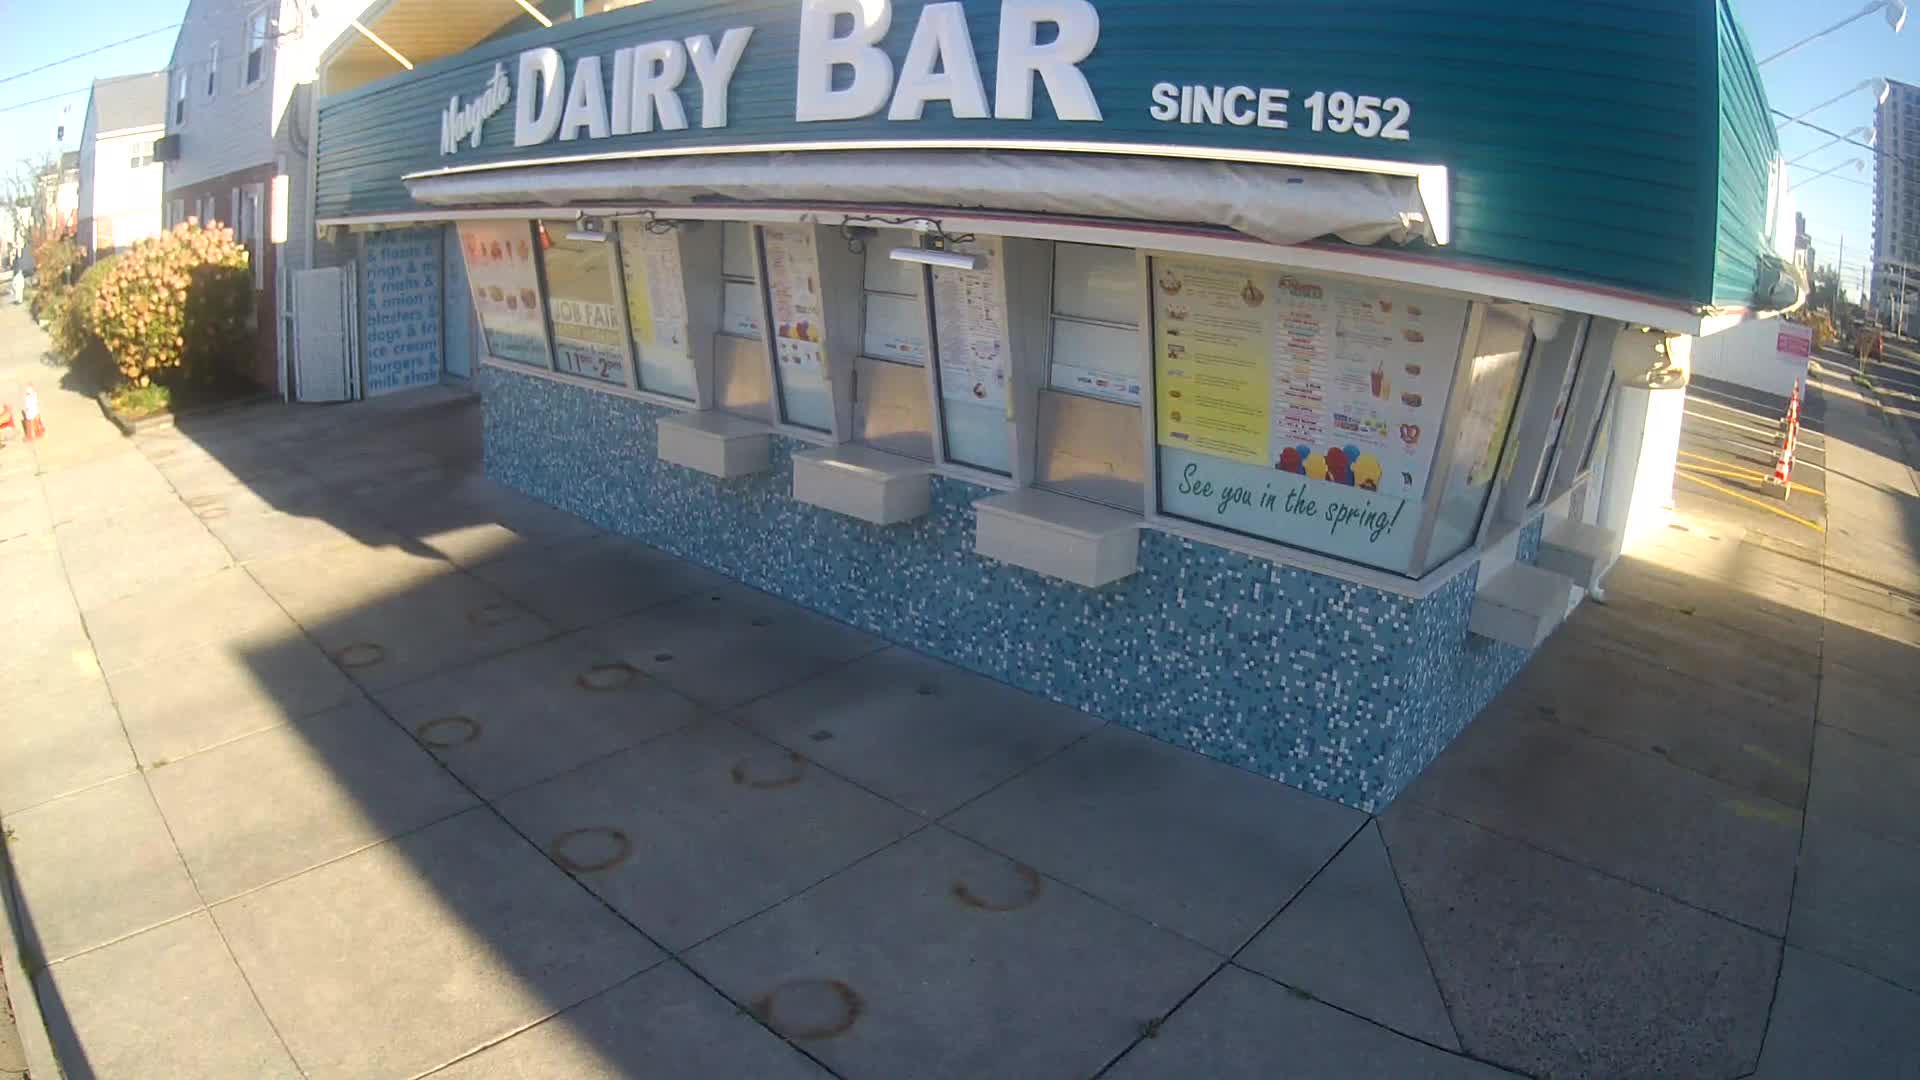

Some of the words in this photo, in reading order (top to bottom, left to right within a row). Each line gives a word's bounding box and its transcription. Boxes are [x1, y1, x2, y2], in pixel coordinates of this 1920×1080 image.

[513, 27, 755, 147] DAIRY
[796, 0, 1103, 123] BAR
[1150, 82, 1290, 129] SINCE
[1304, 91, 1411, 140] 1952
[585, 304, 619, 328] FAIR
[1178, 463, 1213, 496] See
[1217, 485, 1252, 515] you
[1260, 482, 1277, 510] in
[1285, 483, 1318, 517] the
[1325, 499, 1406, 544] spring!
